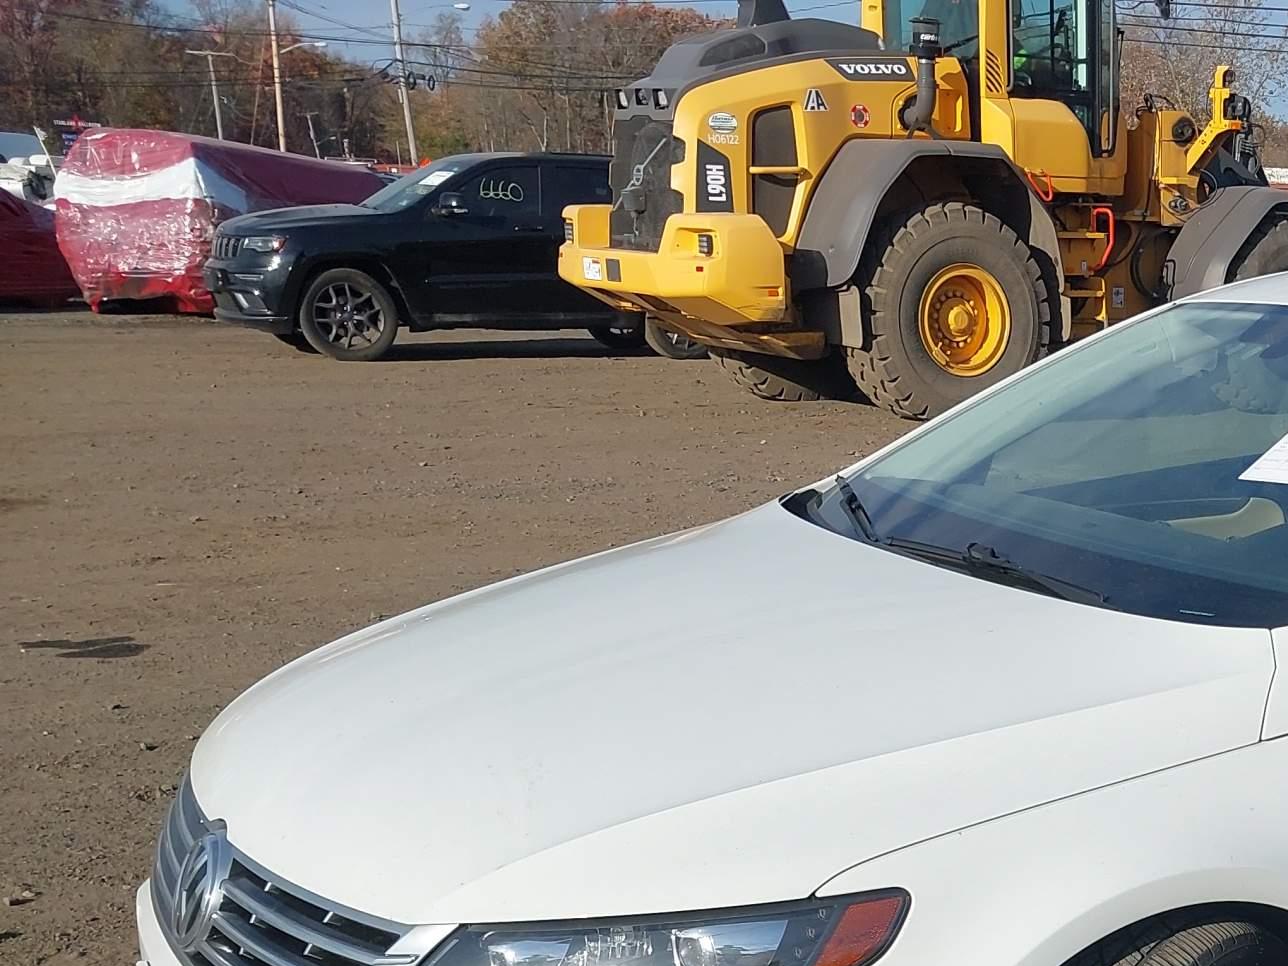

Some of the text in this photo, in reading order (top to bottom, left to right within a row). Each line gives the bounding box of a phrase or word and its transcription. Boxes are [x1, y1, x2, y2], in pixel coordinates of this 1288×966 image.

[838, 63, 907, 75] VOLVO
[707, 133, 740, 145] H06122
[480, 177, 524, 202] 6660
[705, 164, 727, 202] L90H
